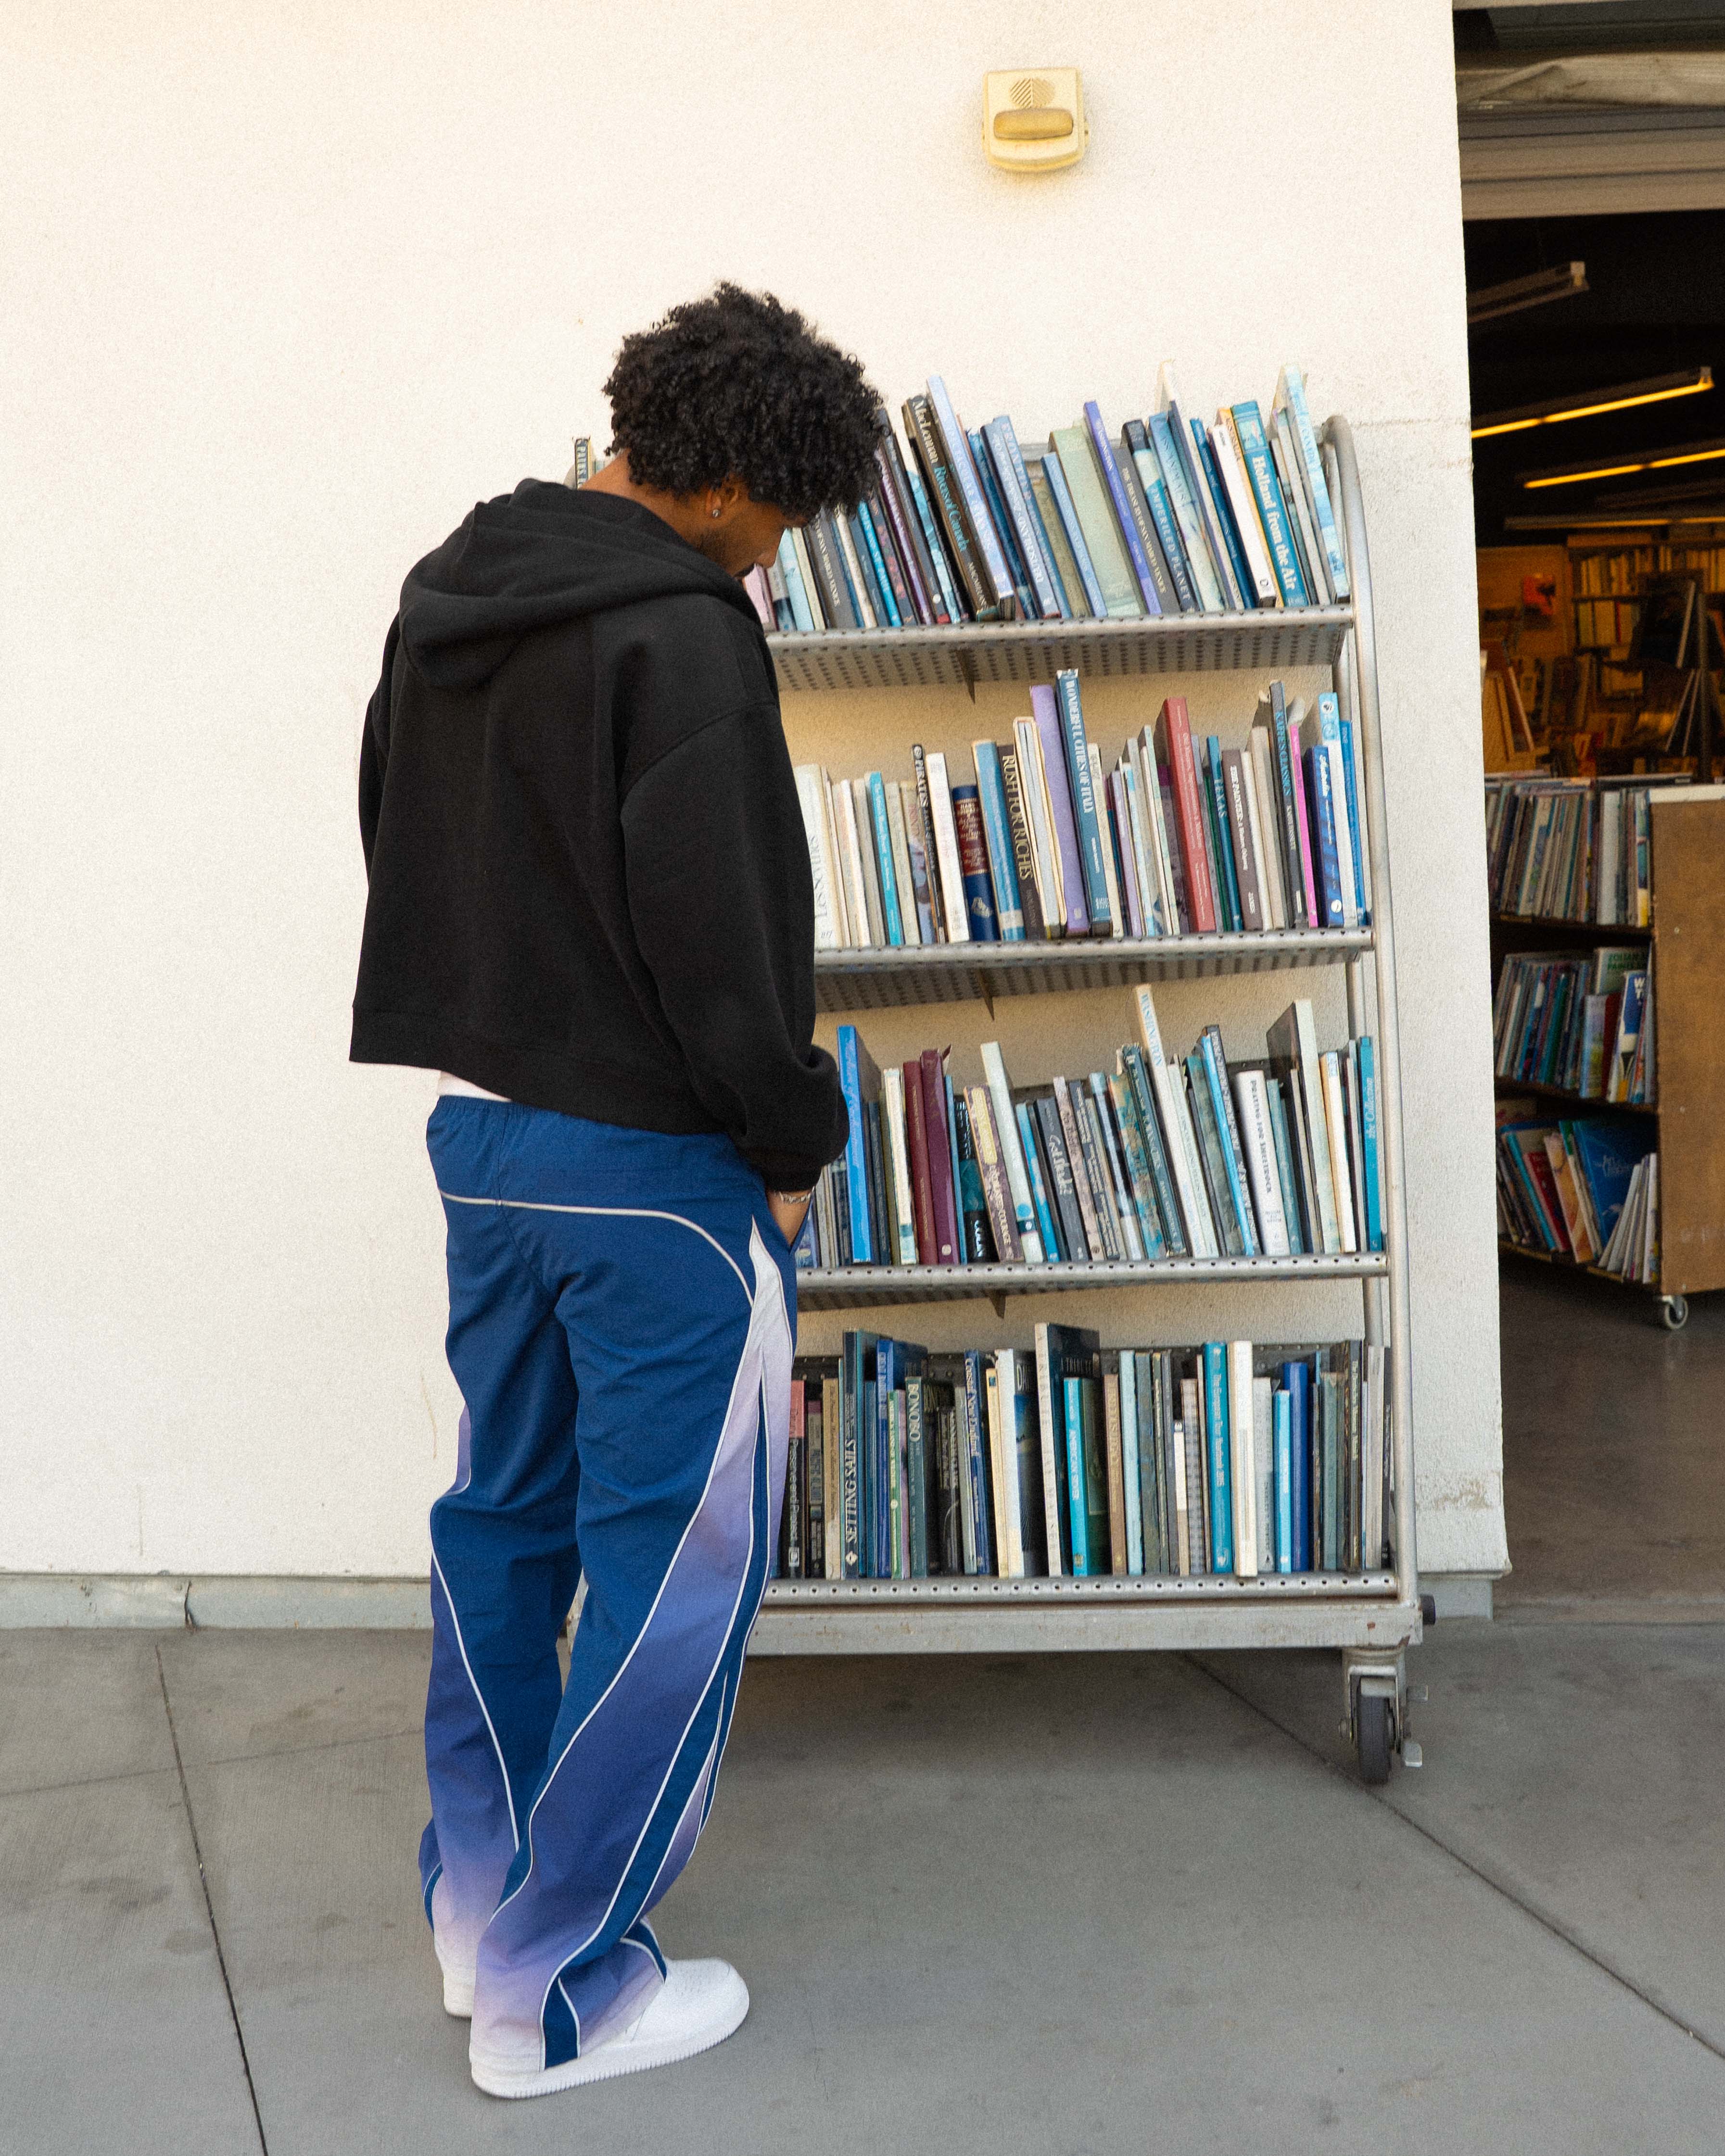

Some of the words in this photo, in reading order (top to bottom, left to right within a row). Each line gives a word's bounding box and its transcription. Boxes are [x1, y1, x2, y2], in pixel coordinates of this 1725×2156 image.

[911, 399, 942, 464] MacLennan
[1251, 455, 1277, 509] Holland
[947, 509, 971, 552] Canada
[1148, 488, 1177, 553] IMPERILED
[1169, 555, 1192, 602] PLANET
[1266, 510, 1286, 544] from
[1275, 542, 1292, 567] the
[1281, 565, 1299, 591] Air
[1065, 679, 1084, 738] WONDERFUL
[1073, 738, 1089, 770] CITIES
[914, 758, 928, 807] PIRATES
[1000, 754, 1020, 793] RUSH
[1078, 771, 1091, 786] OF
[1278, 751, 1292, 796] CLASSICS
[1007, 797, 1025, 825] FOR
[1080, 785, 1095, 813] ITALY
[1214, 778, 1227, 819] TEXAS
[1011, 827, 1034, 881] RICHES
[1140, 993, 1164, 1066] WASHINGTON
[1256, 1121, 1265, 1140] FOR
[1366, 1123, 1375, 1139] the
[1258, 1142, 1274, 1194] SHEETROCK
[996, 1209, 1012, 1245] COURAGE
[964, 1357, 977, 1393] Coastal
[1213, 1374, 1221, 1387] The
[907, 1383, 921, 1442] BONOBO
[966, 1395, 978, 1418] New
[1213, 1388, 1222, 1419] European
[967, 1419, 981, 1457] England
[1068, 1429, 1078, 1474] AMERICAN
[789, 1439, 799, 1484] Preserve
[845, 1439, 857, 1476] SAILS
[789, 1484, 799, 1503] and
[1070, 1474, 1078, 1500] SILVER
[789, 1505, 799, 1540] Protect
[845, 1480, 857, 1544] SETTING
